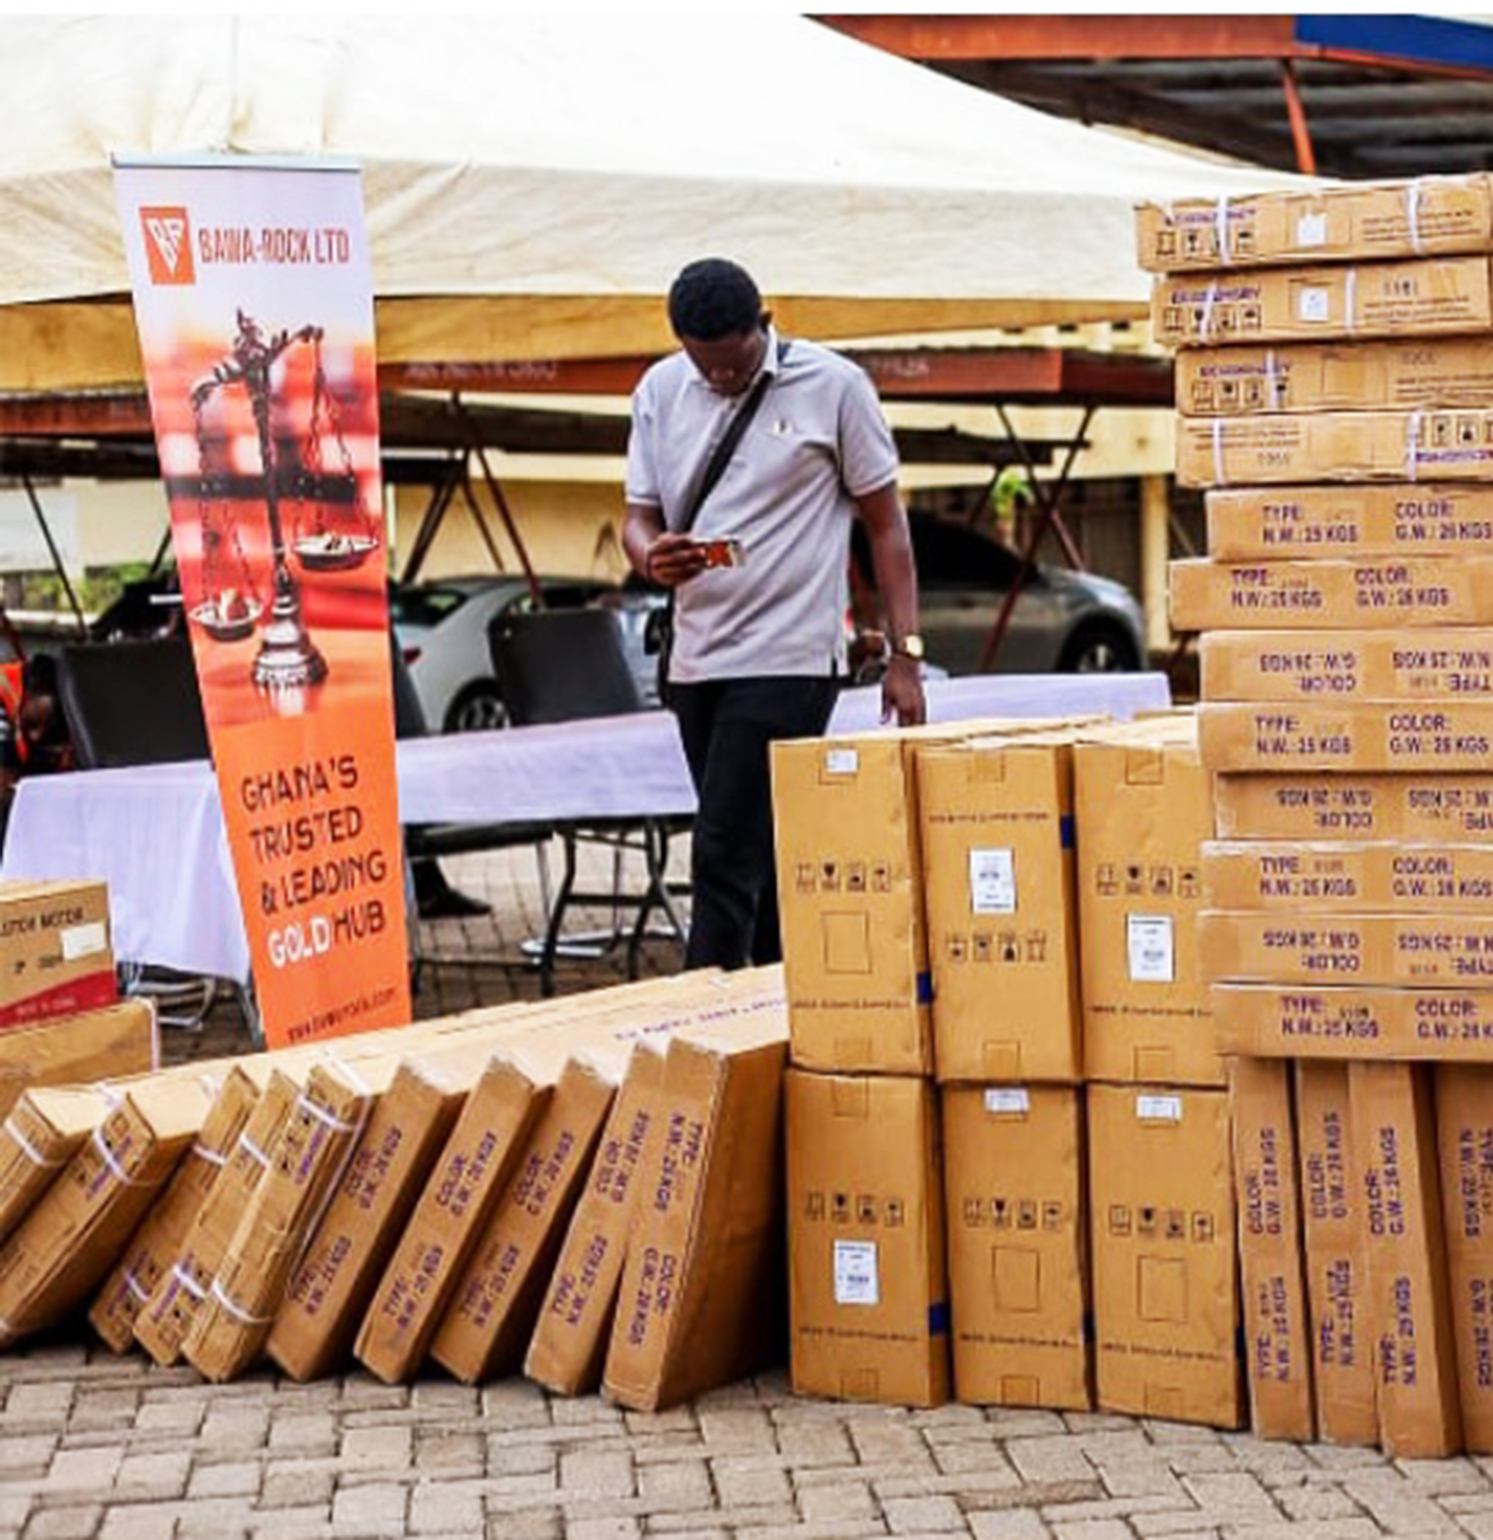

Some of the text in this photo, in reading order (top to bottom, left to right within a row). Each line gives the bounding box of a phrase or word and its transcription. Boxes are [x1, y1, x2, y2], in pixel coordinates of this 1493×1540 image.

[199, 228, 350, 263] BAWA-ROCK LTD
[242, 755, 359, 812] GHANA'S
[249, 806, 363, 864] TRUSTED
[262, 849, 387, 917] & LEADING
[268, 899, 386, 968] GOLD HUB
